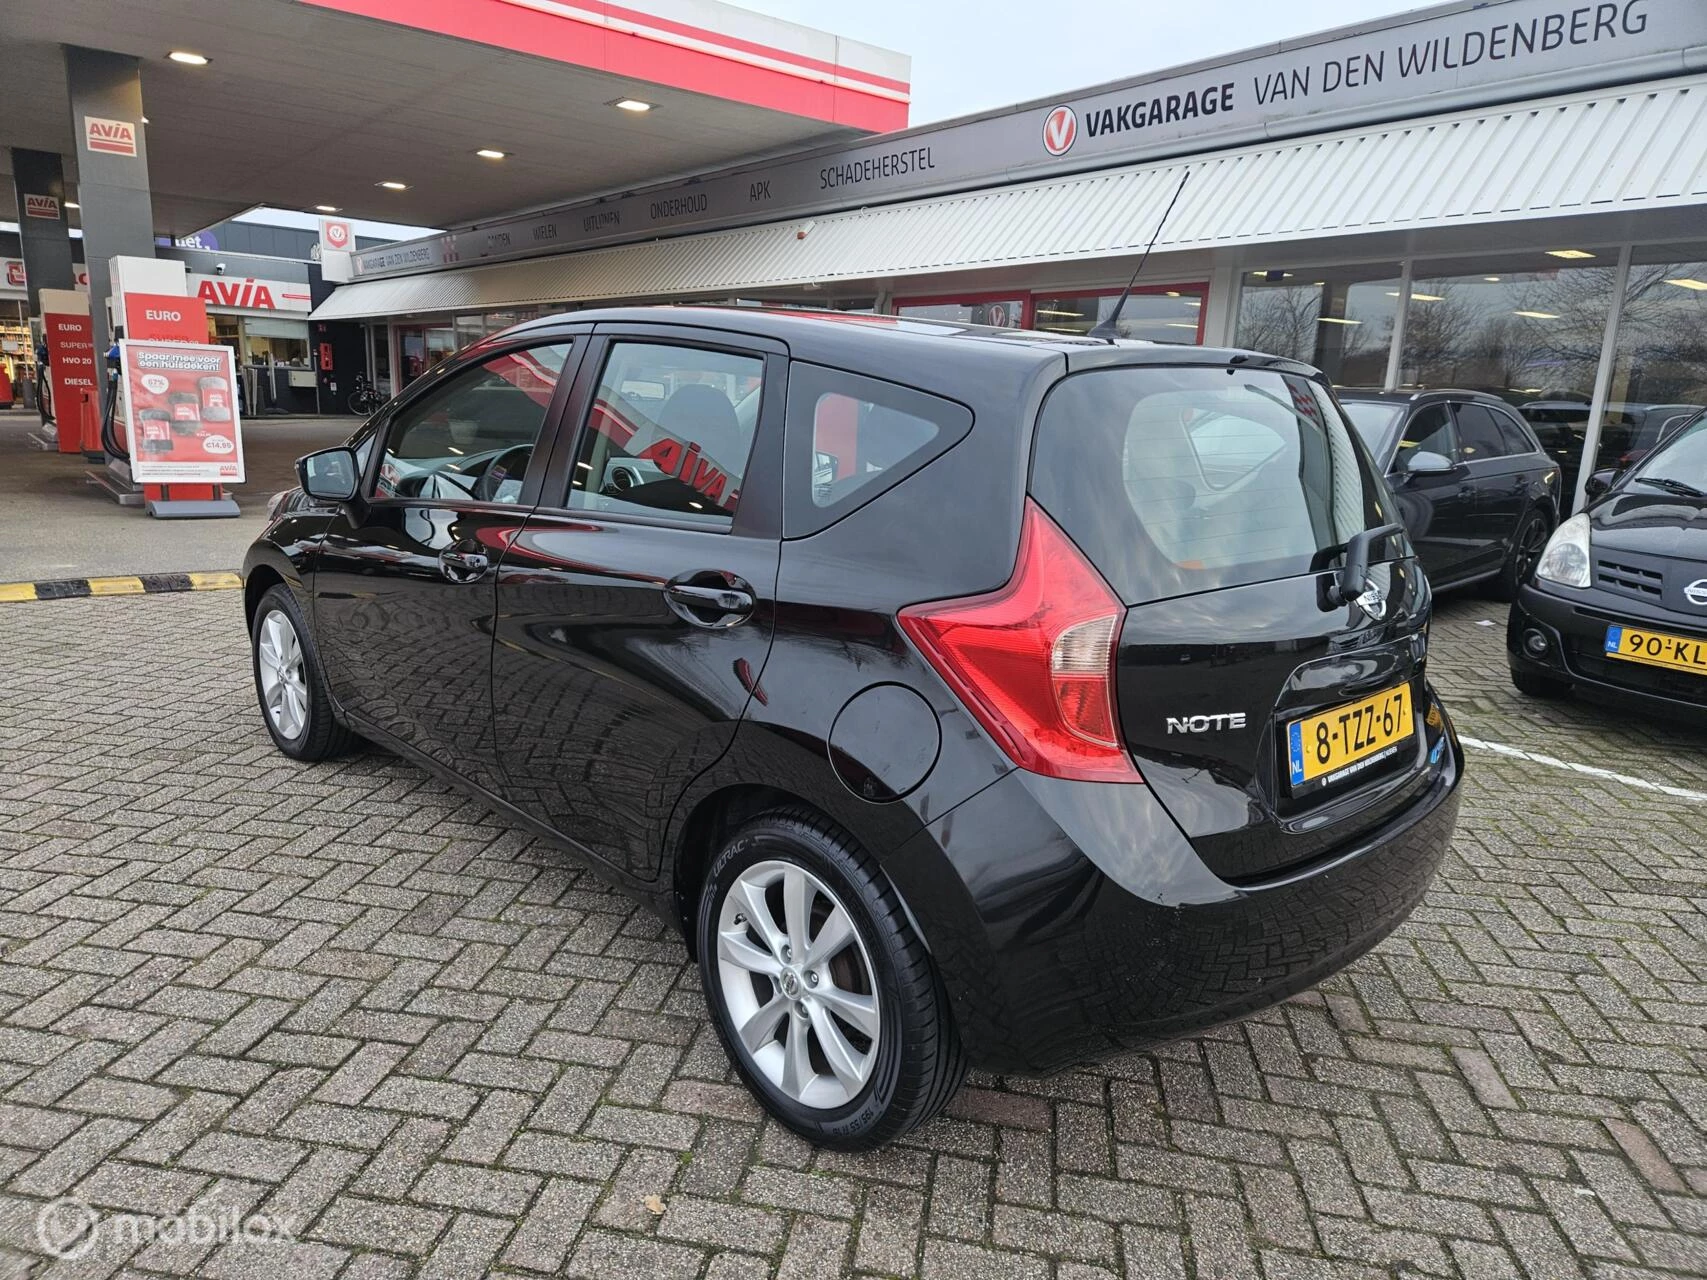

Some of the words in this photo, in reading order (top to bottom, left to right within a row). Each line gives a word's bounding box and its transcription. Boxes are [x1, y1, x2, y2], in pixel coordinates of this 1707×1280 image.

[1086, 82, 1235, 137] VAKGARAGE
[1254, 66, 1310, 105] VAN
[1322, 51, 1385, 92] DEN
[1398, 1, 1648, 78] WILDENBERG
[820, 147, 935, 190] SCHADEHERSTEL
[750, 181, 771, 201] APK
[650, 194, 708, 220] ONDERHOUD
[533, 224, 557, 241] WIELEN
[197, 278, 275, 309] AVIA
[145, 310, 181, 321] EURO
[60, 341, 87, 349] SUPER
[138, 352, 169, 363] Spaar
[1607, 641, 1618, 649] NL
[1166, 712, 1246, 734] NOTE
[1317, 694, 1402, 764] 8-TZZ-67
[1291, 760, 1302, 775] NL
